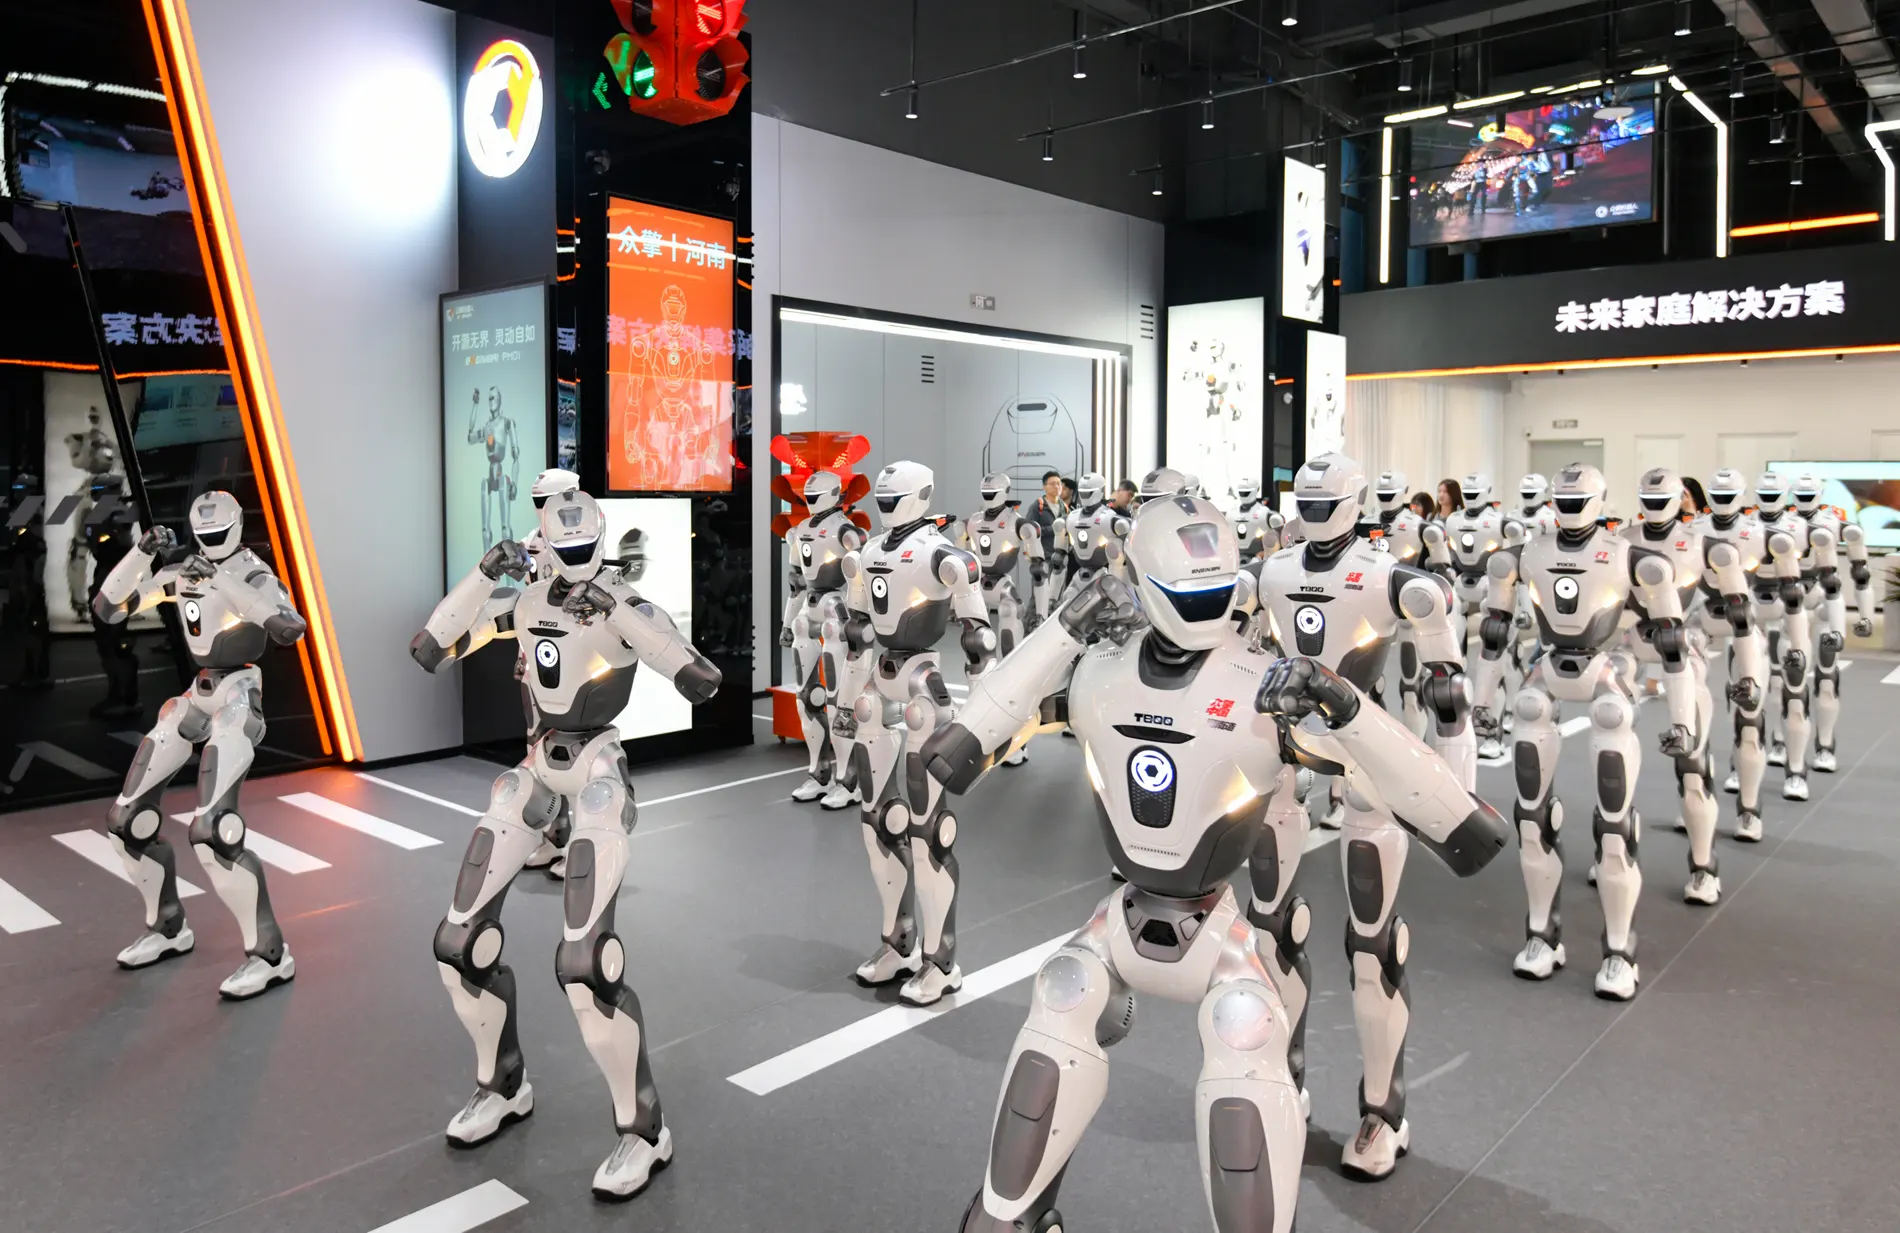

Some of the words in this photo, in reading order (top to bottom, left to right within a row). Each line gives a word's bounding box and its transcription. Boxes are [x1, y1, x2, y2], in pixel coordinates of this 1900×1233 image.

[1555, 280, 1845, 333] 未来家庭解决方案
[495, 324, 536, 347] 灵动自如
[1134, 712, 1174, 726] T800
